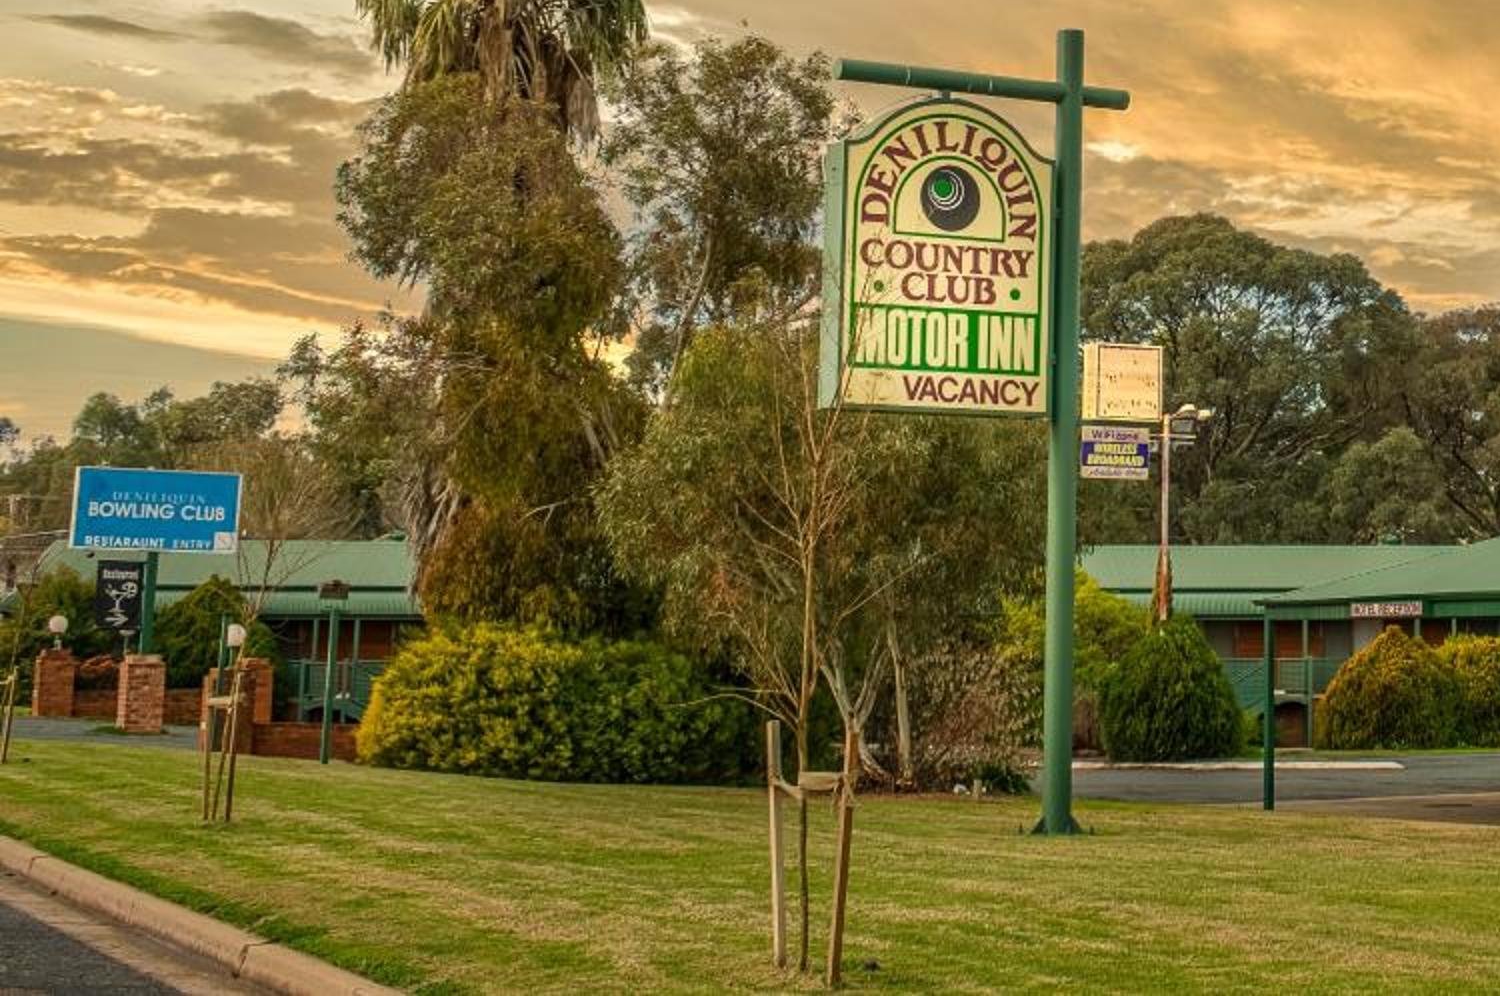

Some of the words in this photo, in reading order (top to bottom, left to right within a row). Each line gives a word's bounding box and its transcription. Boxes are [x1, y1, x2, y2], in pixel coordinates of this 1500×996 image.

[861, 121, 1037, 241] DENILIQUIN
[860, 239, 1034, 278] COUNTRY
[901, 272, 997, 305] CLUB
[856, 307, 969, 369] MOTOR
[978, 315, 1035, 372] INN
[903, 375, 1039, 407] VACANCY
[1088, 454, 1145, 466] BROADBAND
[88, 501, 175, 519] BOWLING
[181, 505, 225, 521] CLUB
[113, 492, 206, 504] DENILIQUIN
[173, 539, 212, 550] ENTRY
